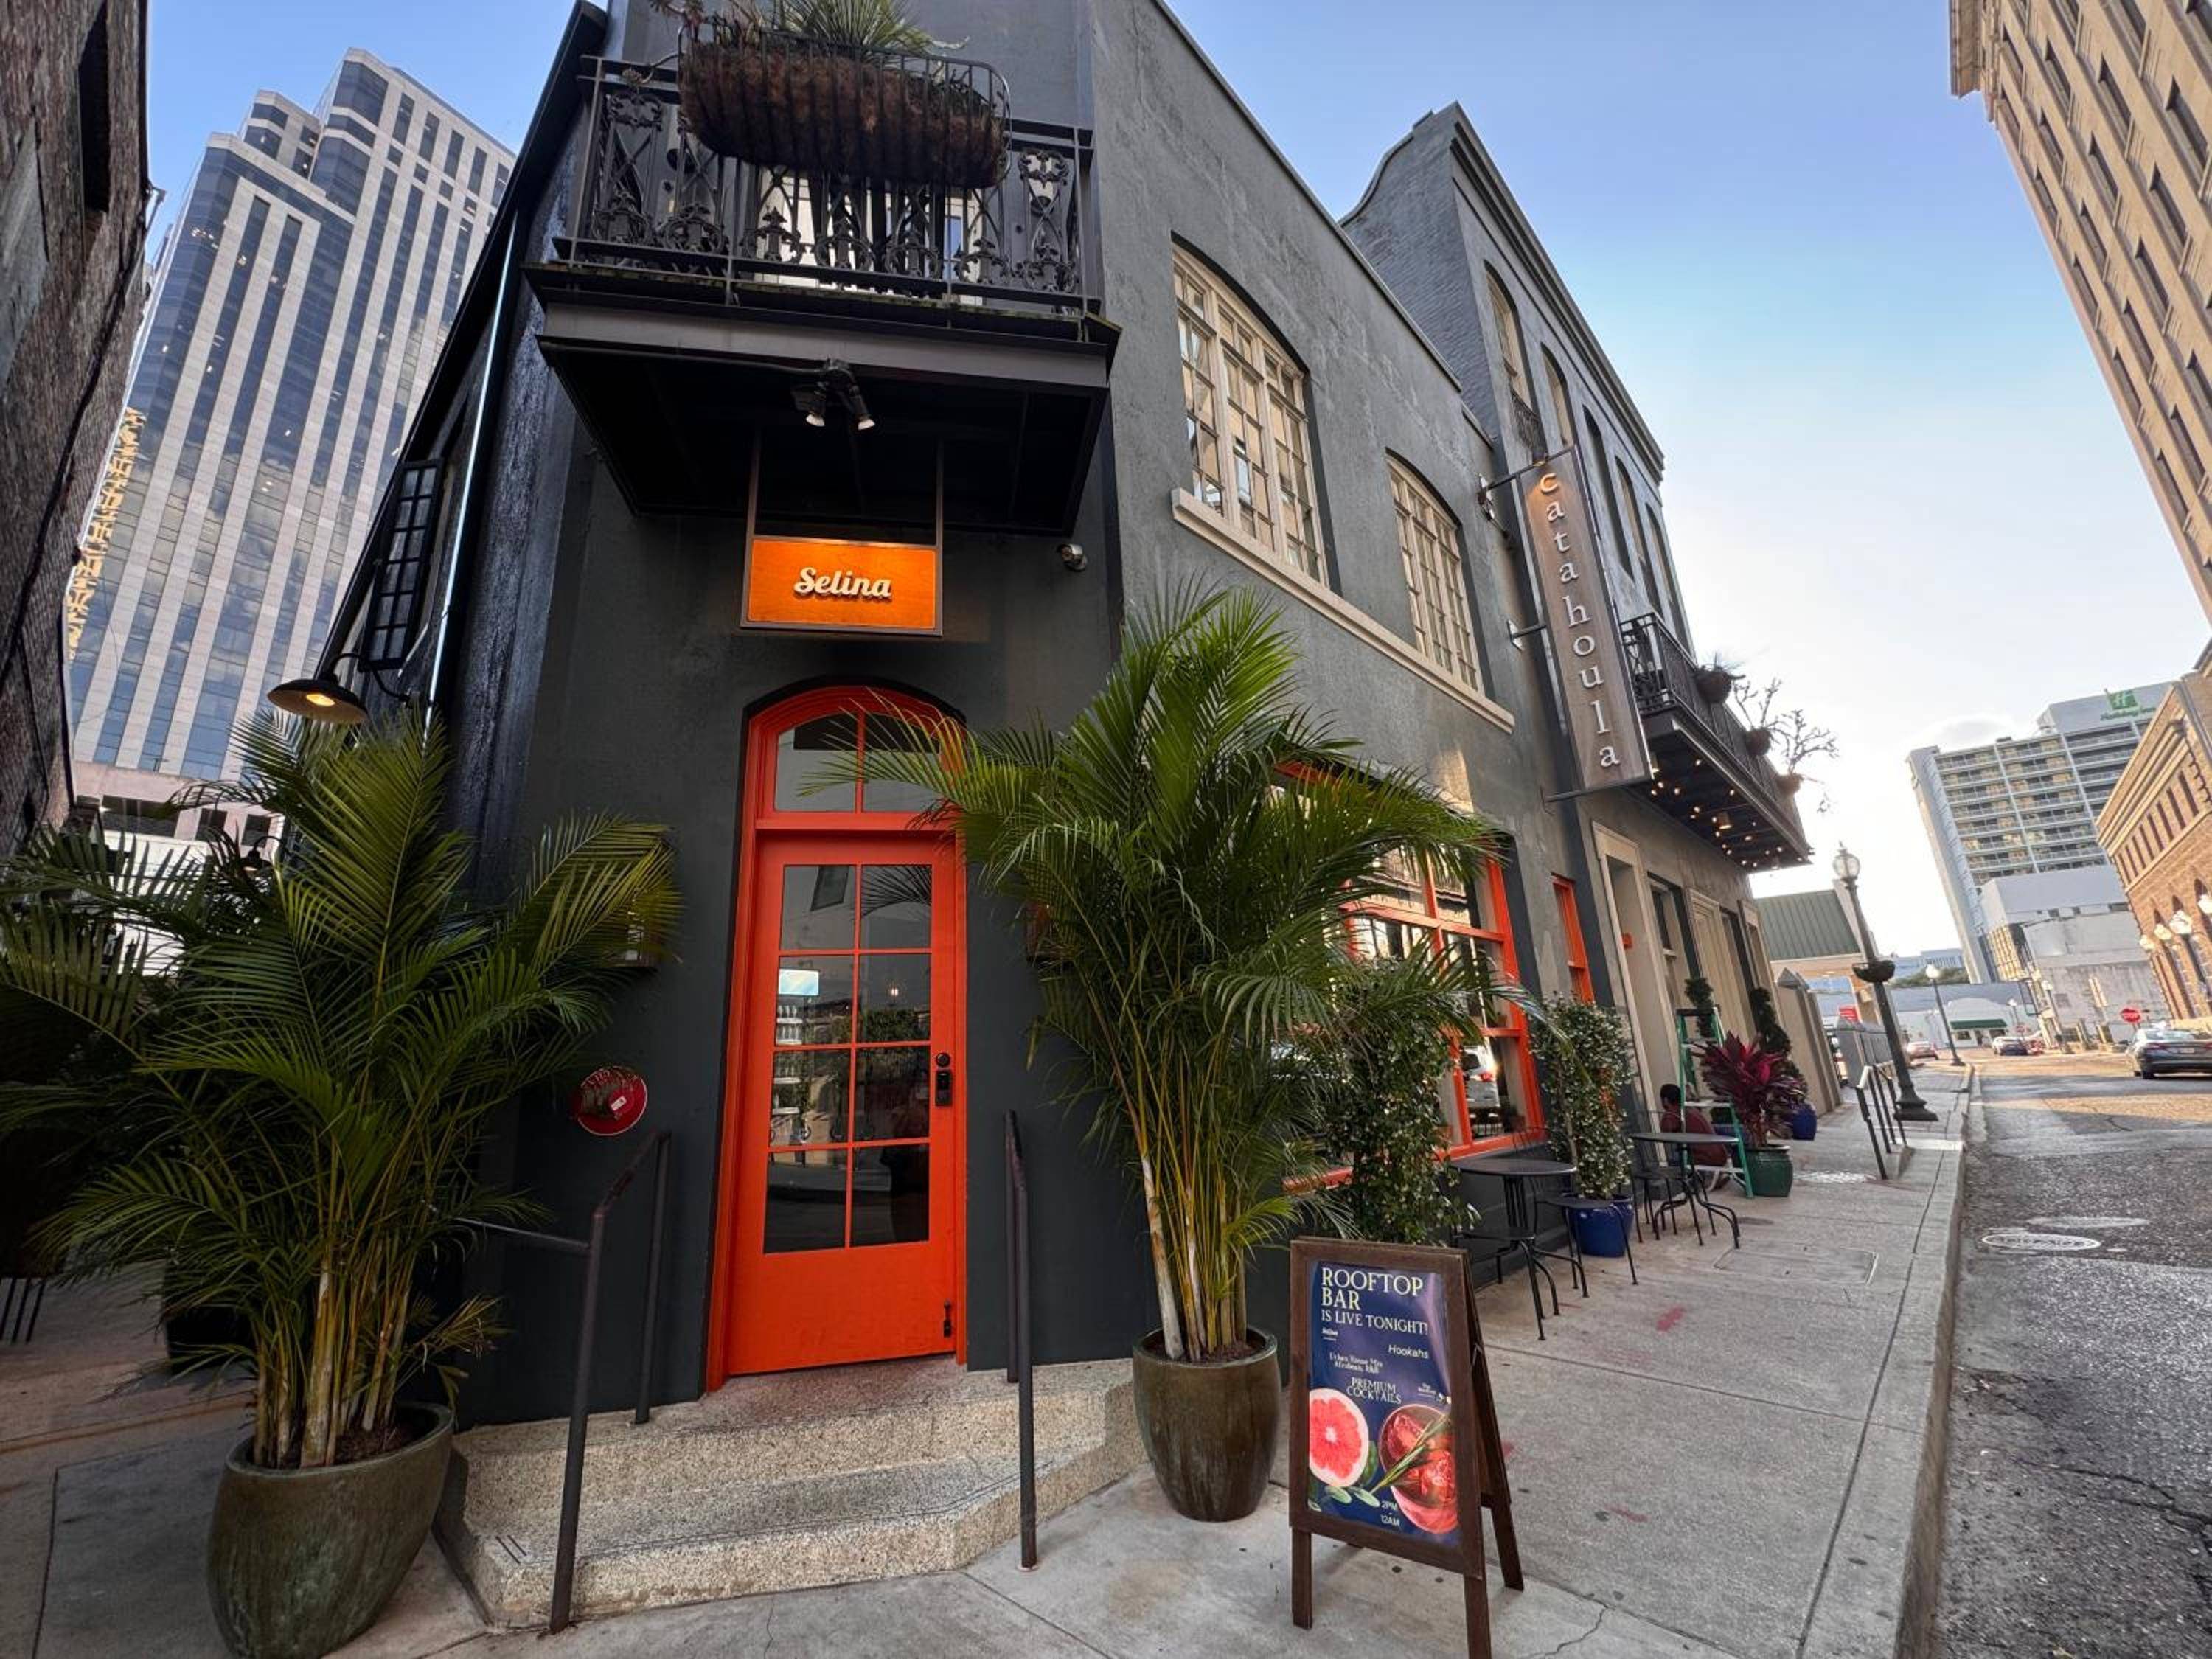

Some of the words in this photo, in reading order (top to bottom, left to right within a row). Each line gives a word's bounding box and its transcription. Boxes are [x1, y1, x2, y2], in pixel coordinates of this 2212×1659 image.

[793, 566, 892, 598] Selina
[1539, 473, 1620, 769] catahoula
[1321, 1267, 1423, 1296] ROOFTOP
[1321, 1287, 1360, 1310] BAR
[1321, 1310, 1332, 1322] IS
[1335, 1311, 1363, 1326] LIVE
[1366, 1315, 1428, 1335] TONIGHT!
[1388, 1344, 1429, 1359] Hookahs
[1346, 1386, 1402, 1405] COCKTAILS
[1351, 1377, 1396, 1394] PREMIUM
